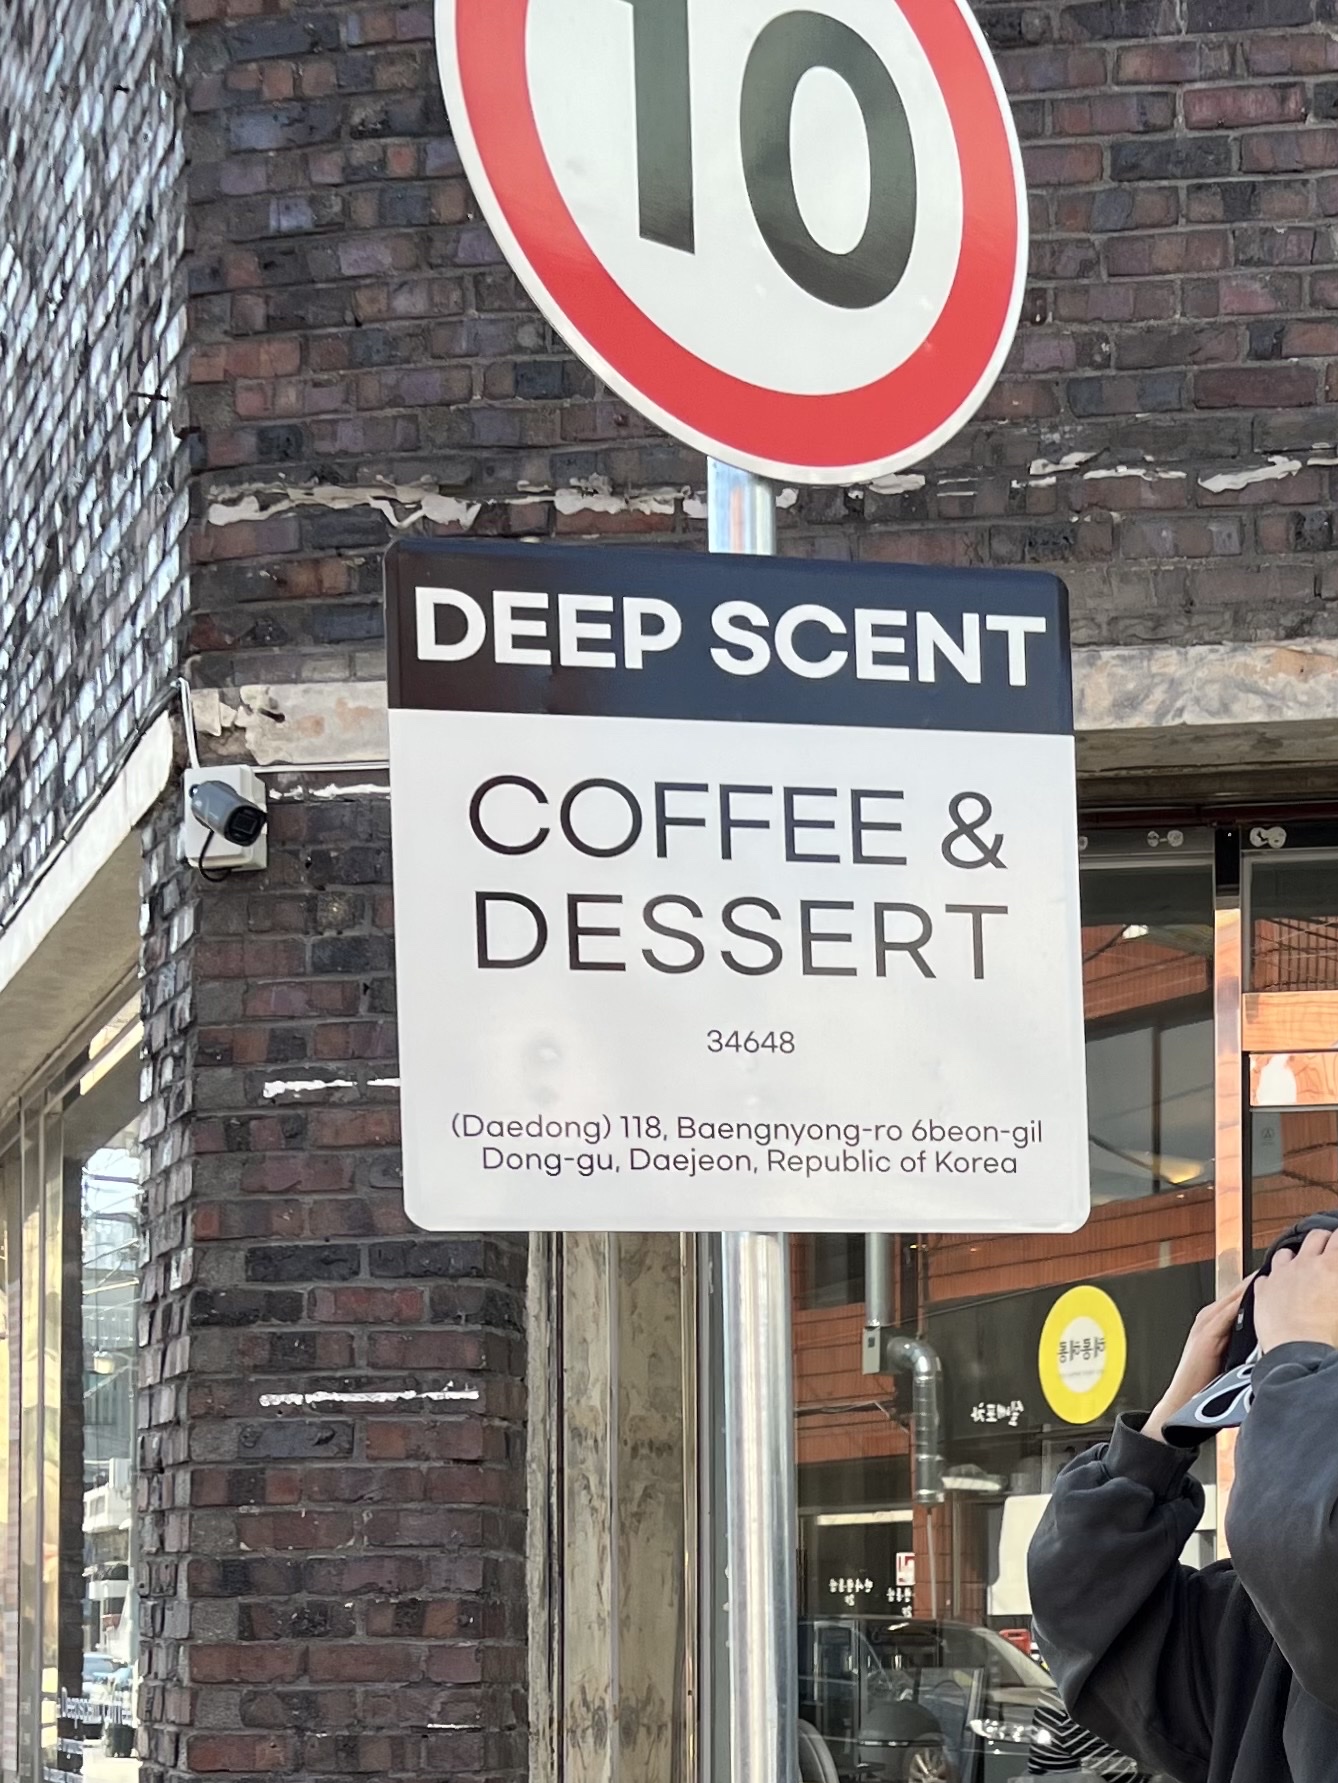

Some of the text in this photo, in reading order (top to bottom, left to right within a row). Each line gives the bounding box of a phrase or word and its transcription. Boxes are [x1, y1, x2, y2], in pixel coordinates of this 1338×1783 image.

[617, 0, 918, 309] 10
[414, 586, 1047, 687] DEEP SCENT
[468, 774, 1008, 870] COFFEE &
[475, 891, 1009, 980] DESSERT
[706, 1029, 796, 1055] 34648
[450, 1112, 1044, 1149] (Daedong) 118, Baengnyong-ro 6beon-gil
[481, 1147, 1018, 1178] Dong-gu, Daejeon, Republic of Korea
